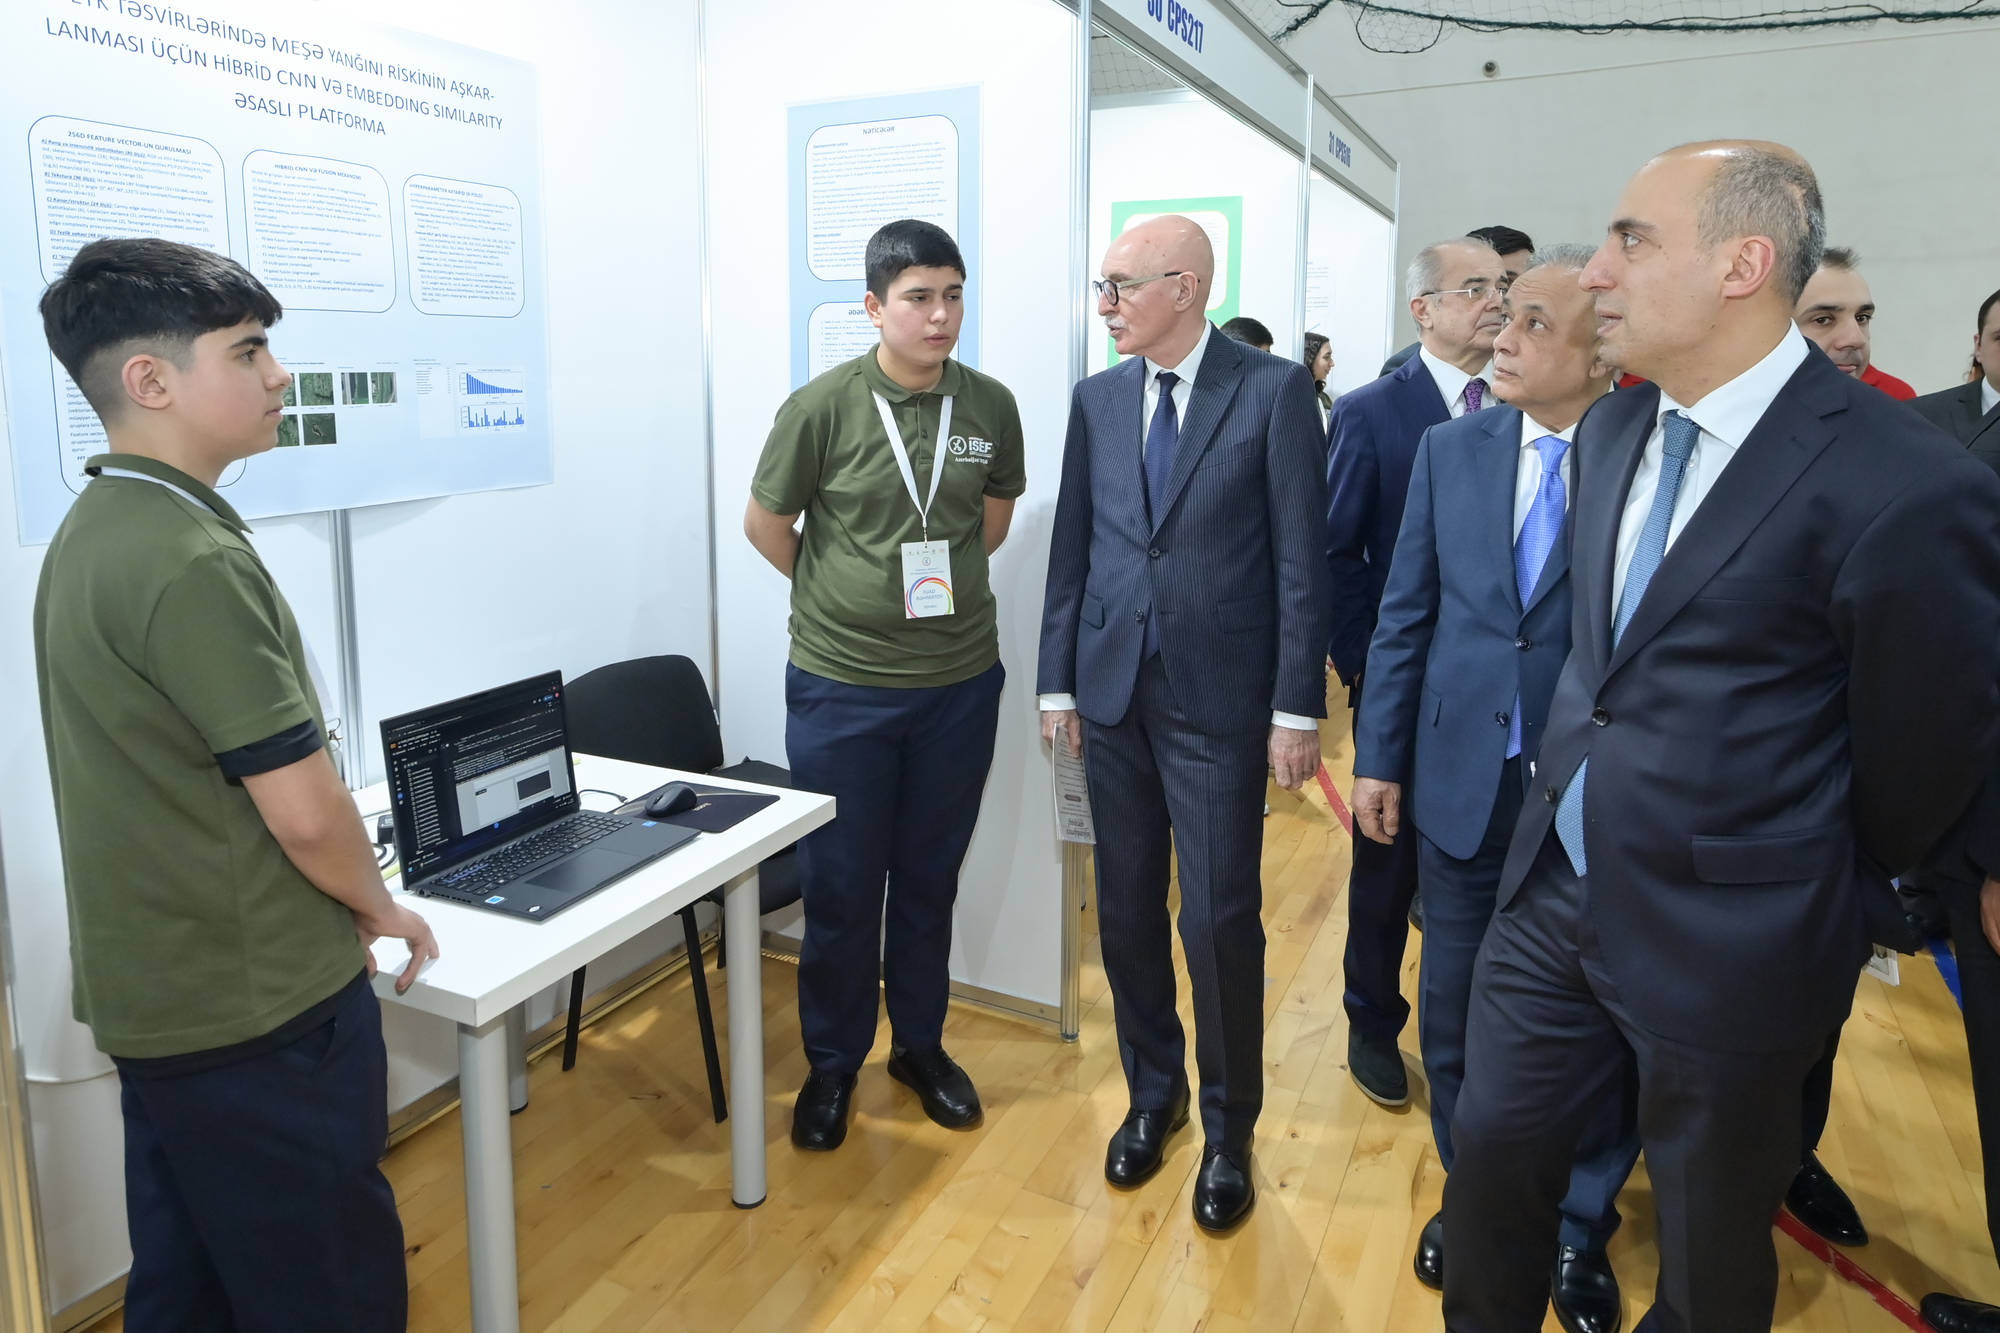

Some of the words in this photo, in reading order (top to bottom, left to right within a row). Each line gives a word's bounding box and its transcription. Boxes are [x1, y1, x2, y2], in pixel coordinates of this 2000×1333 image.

[119, 0, 266, 48] TƏSVİRLƏRİNDƏ
[272, 36, 324, 61] MEŞƏ
[328, 47, 384, 77] YANĞINI
[387, 64, 446, 91] RİSKİNİN
[450, 80, 495, 101] AŞKAR-
[1168, 0, 1204, 53] CPS217
[46, 17, 145, 54] LANMASI
[151, 37, 208, 67] ÜÇÜN
[213, 54, 272, 81] HİBRİD
[276, 70, 316, 89] CNN
[321, 76, 342, 95] VƏ
[346, 84, 430, 115] EMBEDDING
[433, 104, 503, 130] SIMILARITY
[68, 131, 86, 139] 256D
[86, 133, 115, 143] FEATURE
[234, 91, 292, 117] ƏSASLI
[298, 104, 387, 135] PLATFORMA
[968, 440, 993, 453] ISEF
